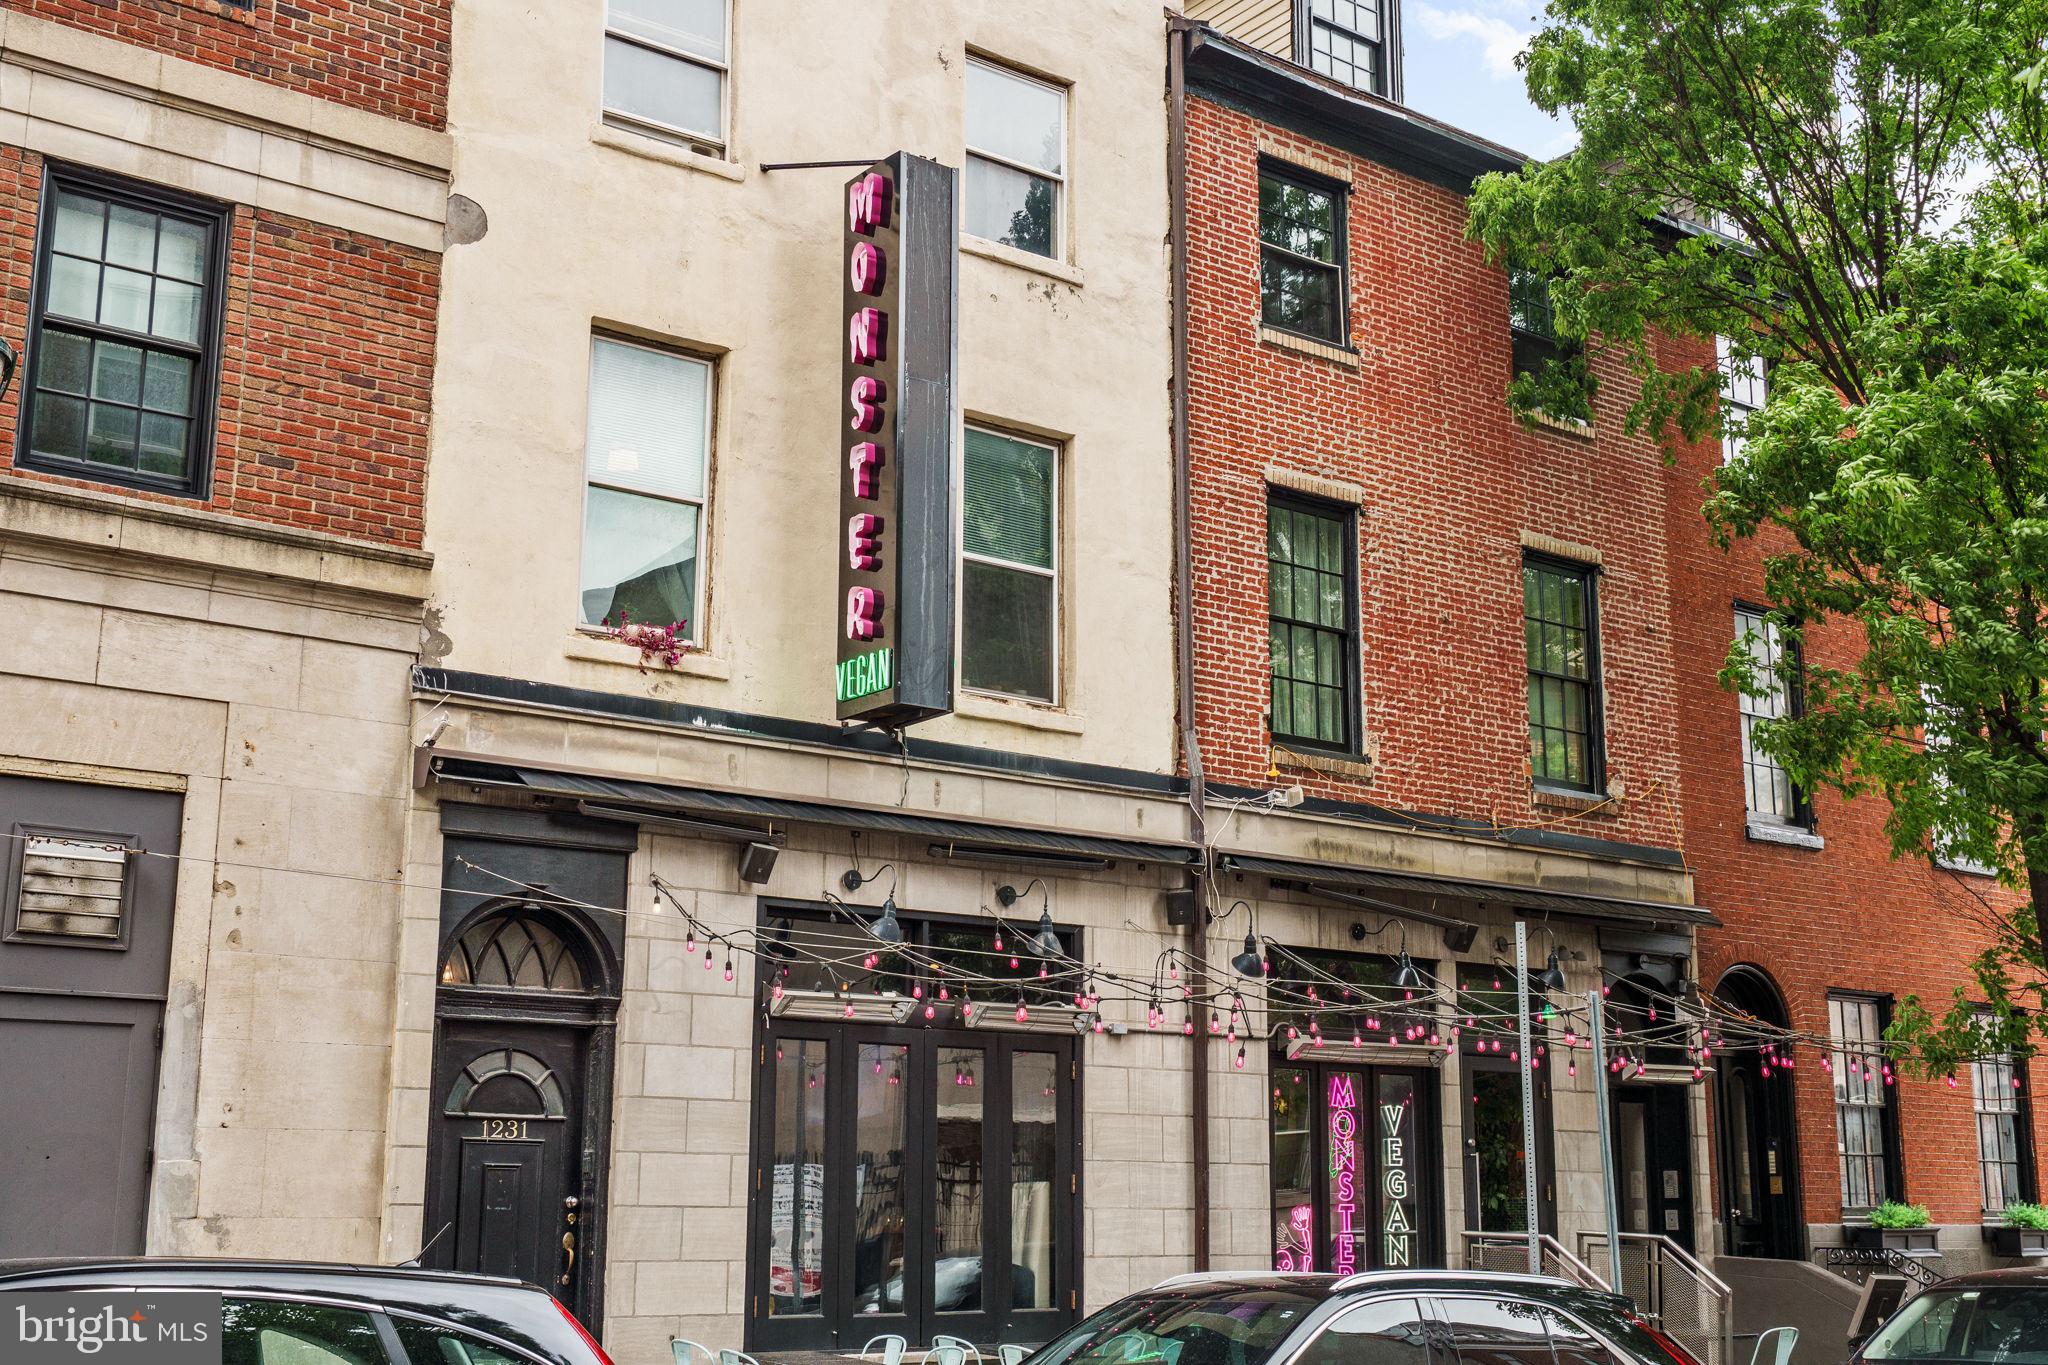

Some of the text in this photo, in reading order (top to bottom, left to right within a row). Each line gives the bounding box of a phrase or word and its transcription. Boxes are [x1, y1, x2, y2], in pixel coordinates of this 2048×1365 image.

[846, 172, 893, 642] MONSTER
[835, 648, 889, 700] VEGAN
[481, 1119, 528, 1139] 1231
[1382, 1104, 1410, 1267] VEGAN
